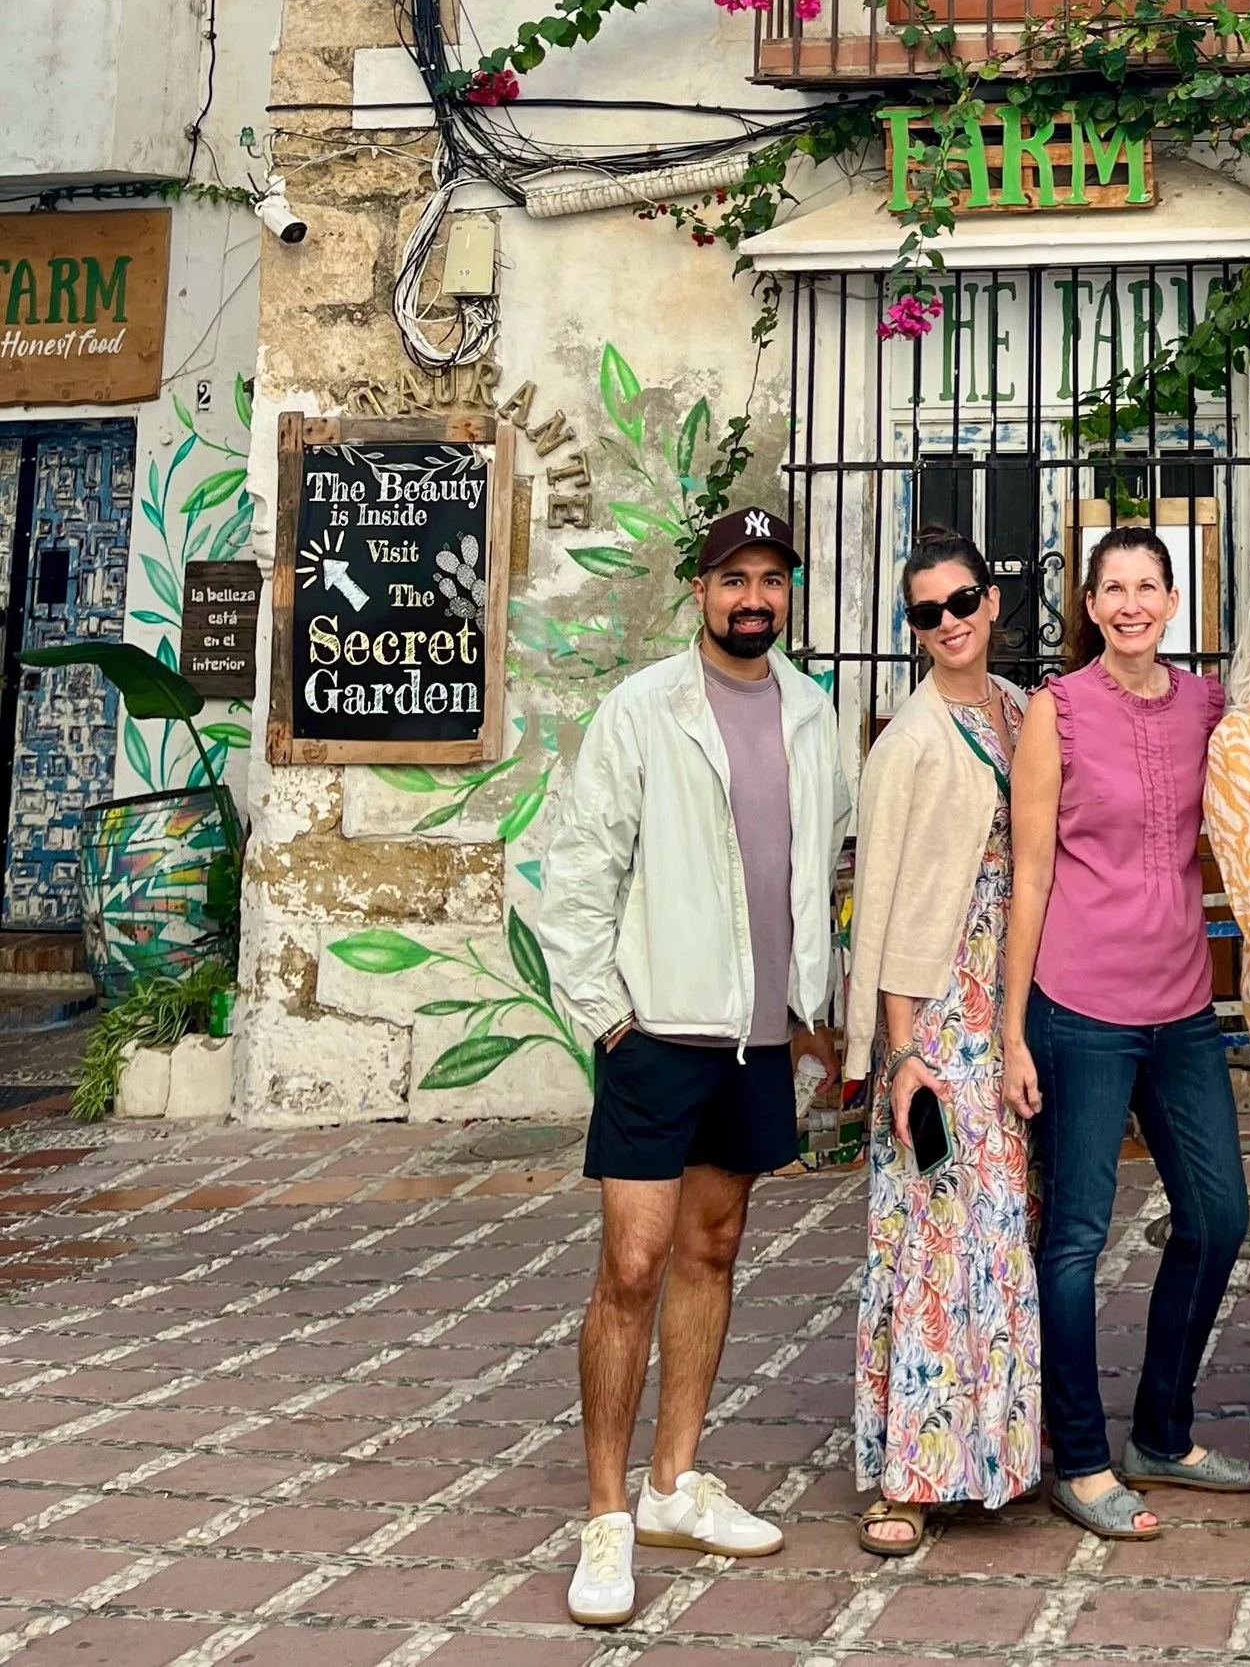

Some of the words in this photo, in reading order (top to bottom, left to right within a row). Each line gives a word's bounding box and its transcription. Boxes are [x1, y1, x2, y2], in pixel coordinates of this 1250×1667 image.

[1, 330, 77, 360] Honest
[197, 380, 213, 410] 2
[306, 471, 366, 503] The
[376, 471, 486, 510] Beauty
[329, 504, 349, 526] is
[356, 503, 428, 526] Inside
[744, 510, 771, 537] NY
[366, 539, 420, 564] Visit
[191, 588, 205, 603] la
[206, 586, 256, 603] belleza
[388, 584, 436, 608] The
[208, 609, 238, 625] está
[203, 635, 220, 647] en
[222, 633, 236, 647] el
[308, 615, 478, 665] Secret
[192, 656, 246, 672] interior
[304, 669, 482, 715] Garden
